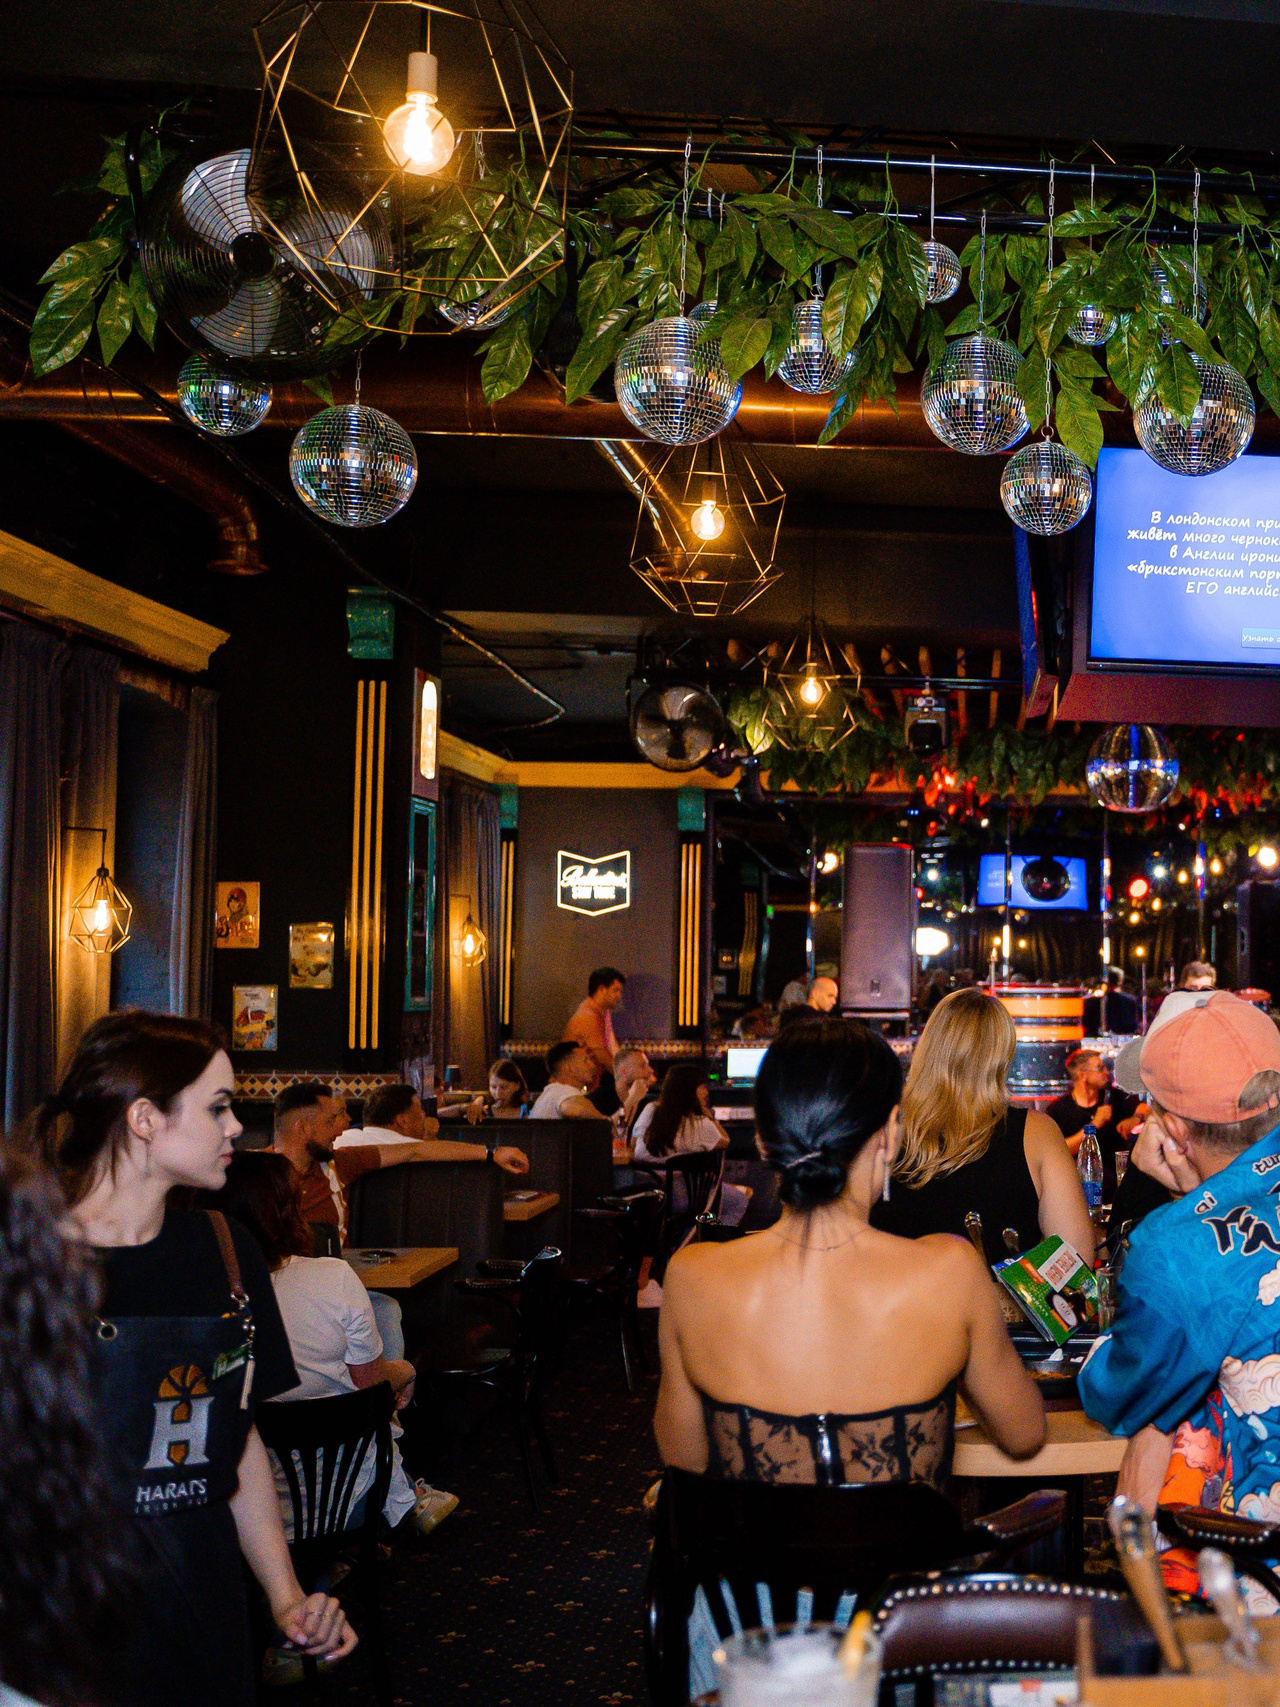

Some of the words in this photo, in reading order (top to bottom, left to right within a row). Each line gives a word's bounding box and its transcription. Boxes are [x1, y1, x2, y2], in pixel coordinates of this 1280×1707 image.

[1150, 511, 1162, 524] В
[1166, 511, 1251, 528] лондонском
[1127, 526, 1177, 541] живёт
[1182, 532, 1226, 544] много
[1169, 544, 1179, 558] в
[1182, 546, 1235, 560] Англии
[1126, 560, 1244, 579] «брикстонским
[1186, 581, 1218, 594] ЕГО
[1242, 633, 1274, 643] Узнать
